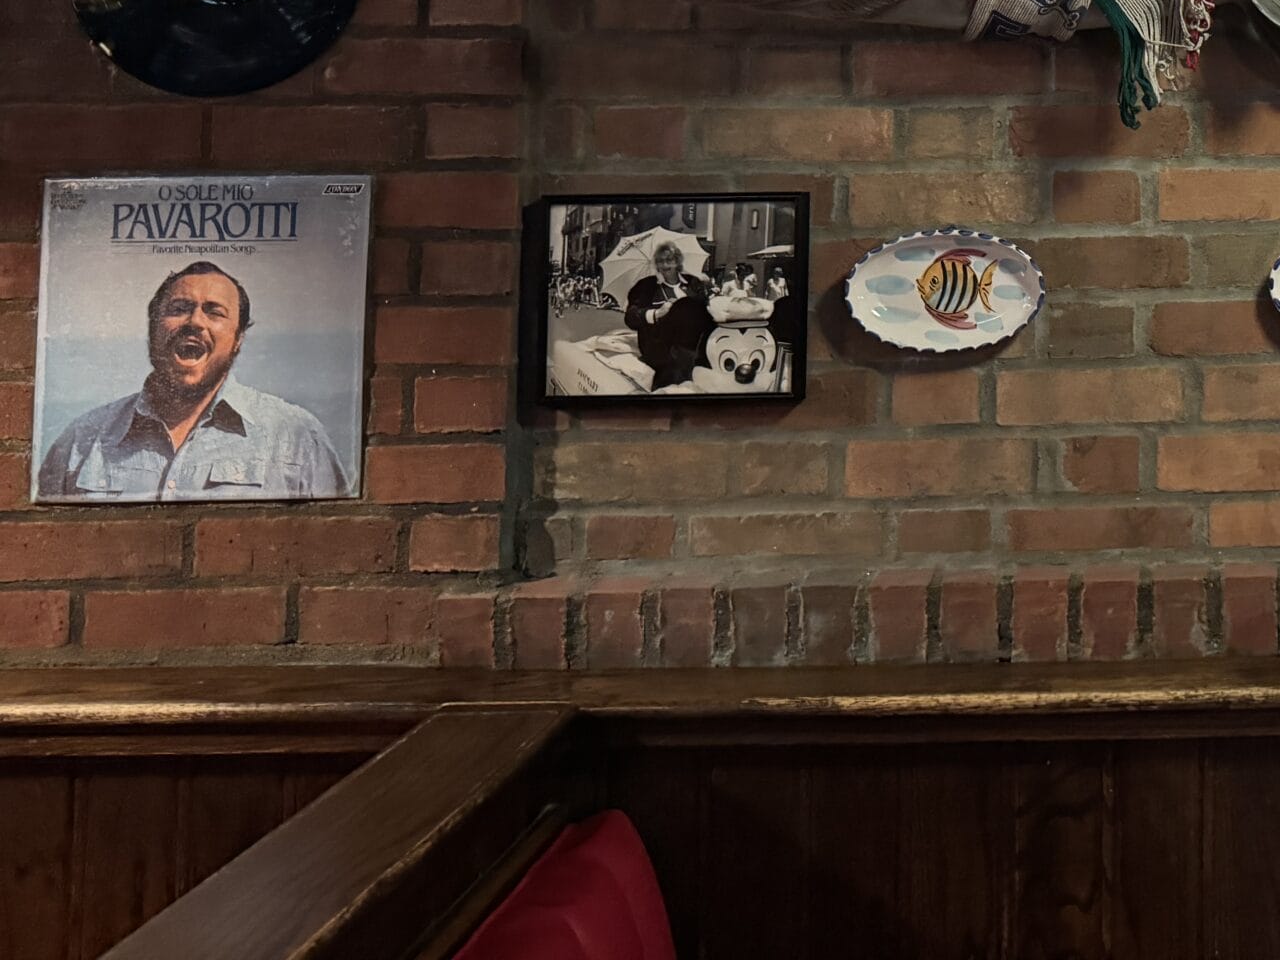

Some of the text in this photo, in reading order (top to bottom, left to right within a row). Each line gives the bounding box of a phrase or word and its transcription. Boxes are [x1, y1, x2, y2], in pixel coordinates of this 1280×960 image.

[158, 185, 254, 201] O SOLE MIO
[112, 202, 298, 240] PAVAROTTI
[152, 244, 183, 253] Favorite
[231, 244, 256, 255] Songs
